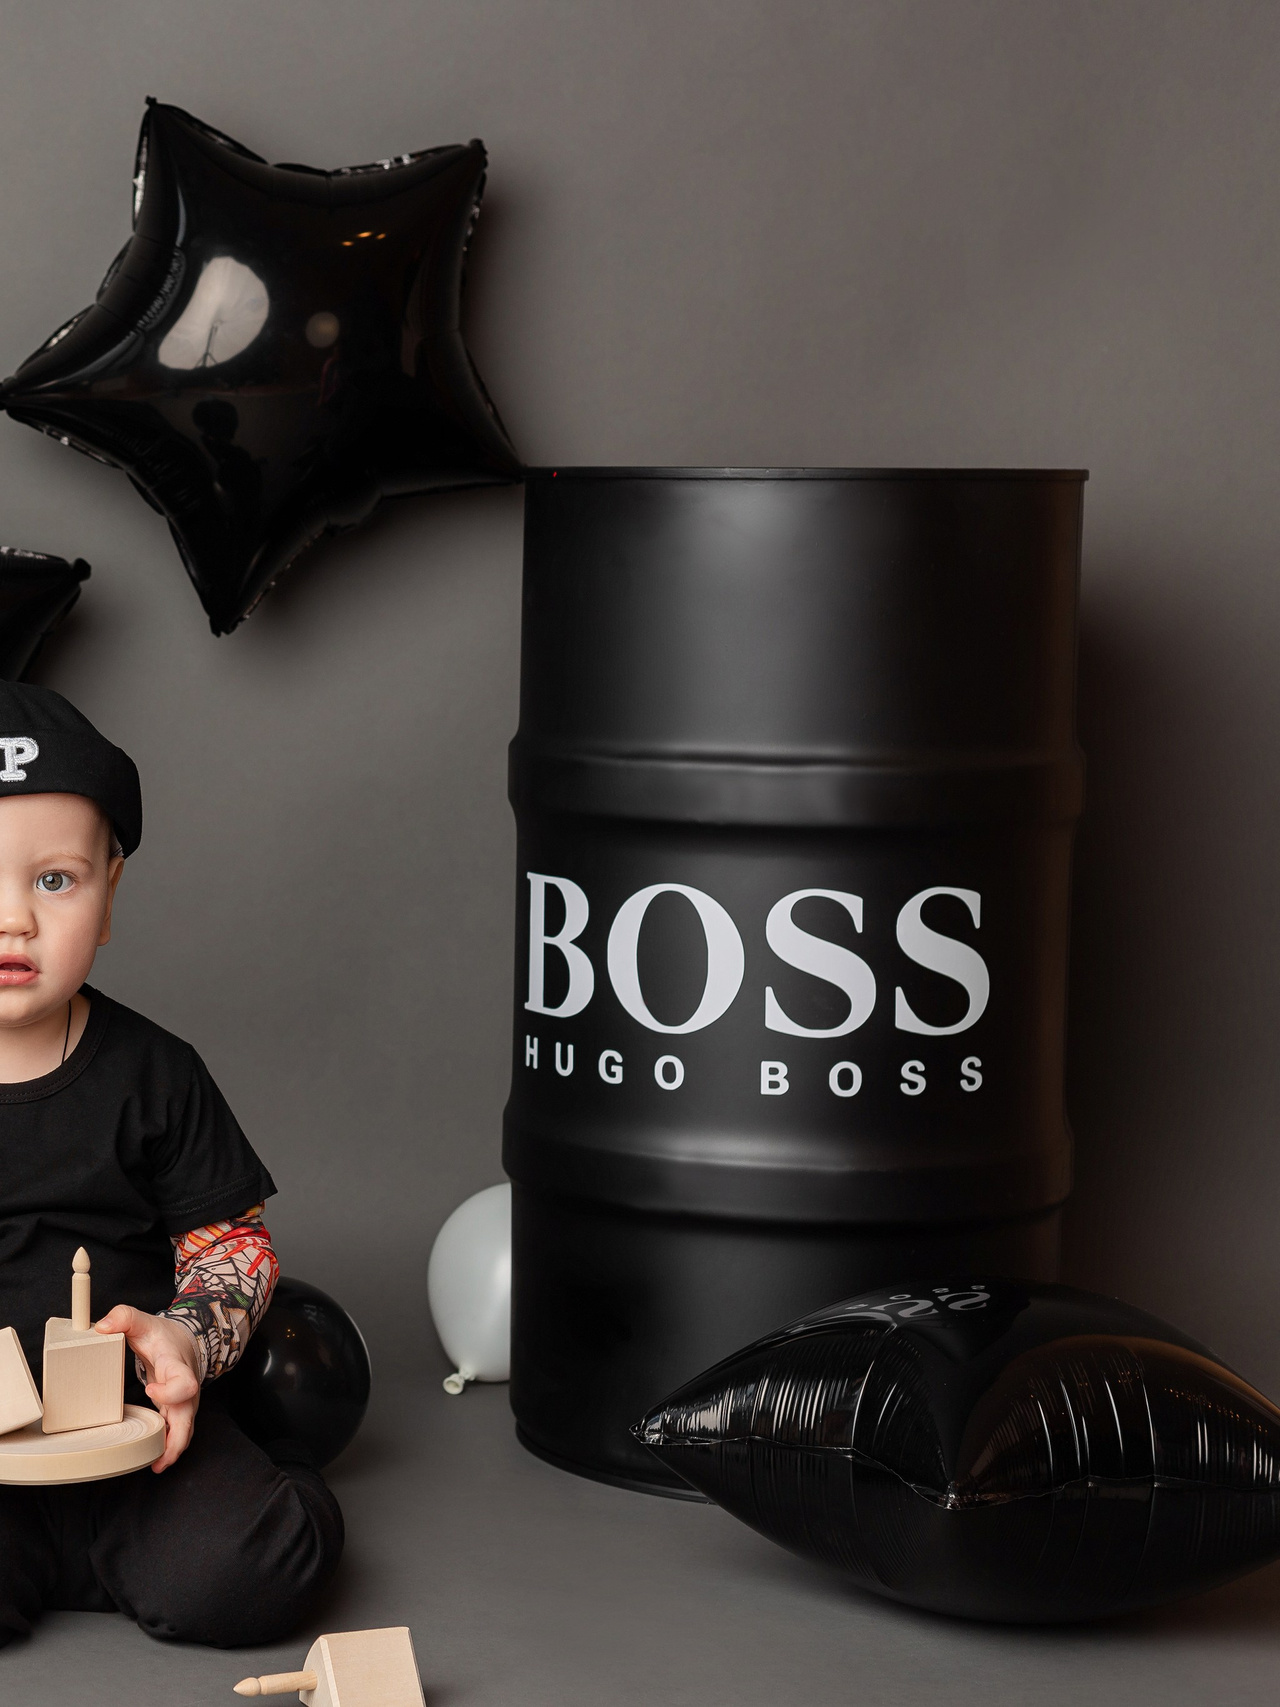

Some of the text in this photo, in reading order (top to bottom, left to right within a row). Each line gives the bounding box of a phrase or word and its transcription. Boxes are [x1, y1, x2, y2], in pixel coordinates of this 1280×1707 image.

[524, 871, 990, 1039] BOSS
[524, 1034, 983, 1098] HUGO BOSS
